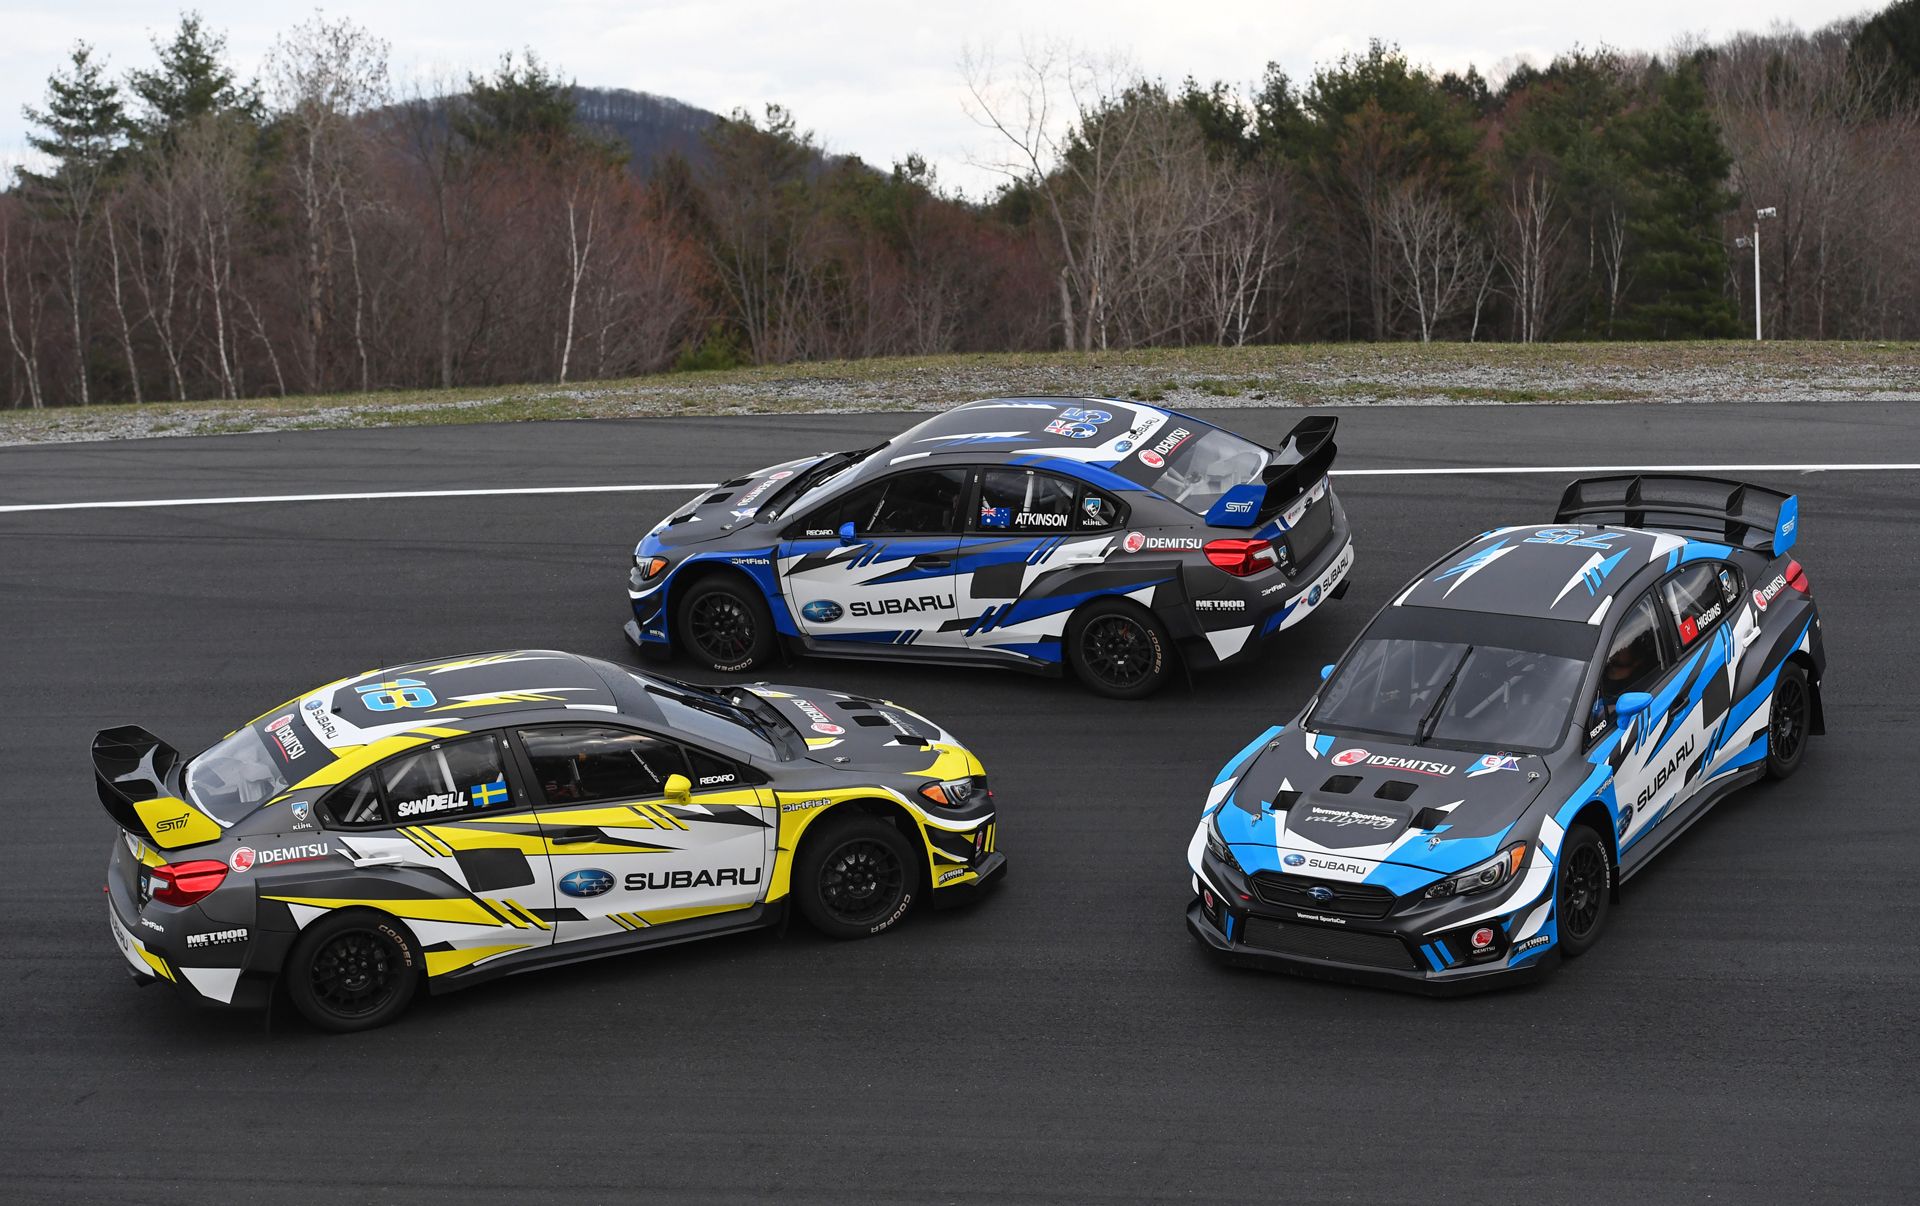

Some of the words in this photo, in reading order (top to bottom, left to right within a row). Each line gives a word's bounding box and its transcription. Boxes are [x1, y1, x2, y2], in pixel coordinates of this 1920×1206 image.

[1044, 407, 1113, 439] 55
[1128, 416, 1160, 442] SUBARU
[1154, 427, 1191, 456] IDEMITSU
[1014, 512, 1068, 528] ATKINSON
[1146, 538, 1203, 550] IDEMITSU
[1323, 553, 1349, 593] SUBARU
[1762, 574, 1788, 601] IDEMITSU
[849, 594, 956, 617] SUBARU
[1195, 600, 1246, 608] METHOD
[1696, 602, 1722, 631] HIGGINS
[1147, 629, 1162, 674] COOPER
[714, 658, 753, 671] COOPER
[354, 678, 438, 712] 18
[311, 708, 339, 740] SUBARU
[1589, 719, 1608, 739] RECARO
[275, 725, 307, 760] IDEMITSU
[1366, 754, 1456, 777] IDEMITSU
[1637, 733, 1696, 813] SUBARU
[699, 773, 735, 785] RECARO
[398, 791, 469, 818] SANDELL
[781, 797, 832, 814] DirtFish
[1312, 806, 1350, 817] Vermont
[1351, 811, 1398, 824] SportsCar
[258, 842, 328, 864] IDEMITSU
[1308, 858, 1367, 875] SUBARU
[624, 868, 761, 891] SUBARU
[871, 894, 911, 933] COOPER
[1297, 912, 1319, 921] Vermont
[186, 928, 248, 945] METHOD
[378, 924, 412, 967] COOPER
[1472, 946, 1496, 954] IDEMITSU
